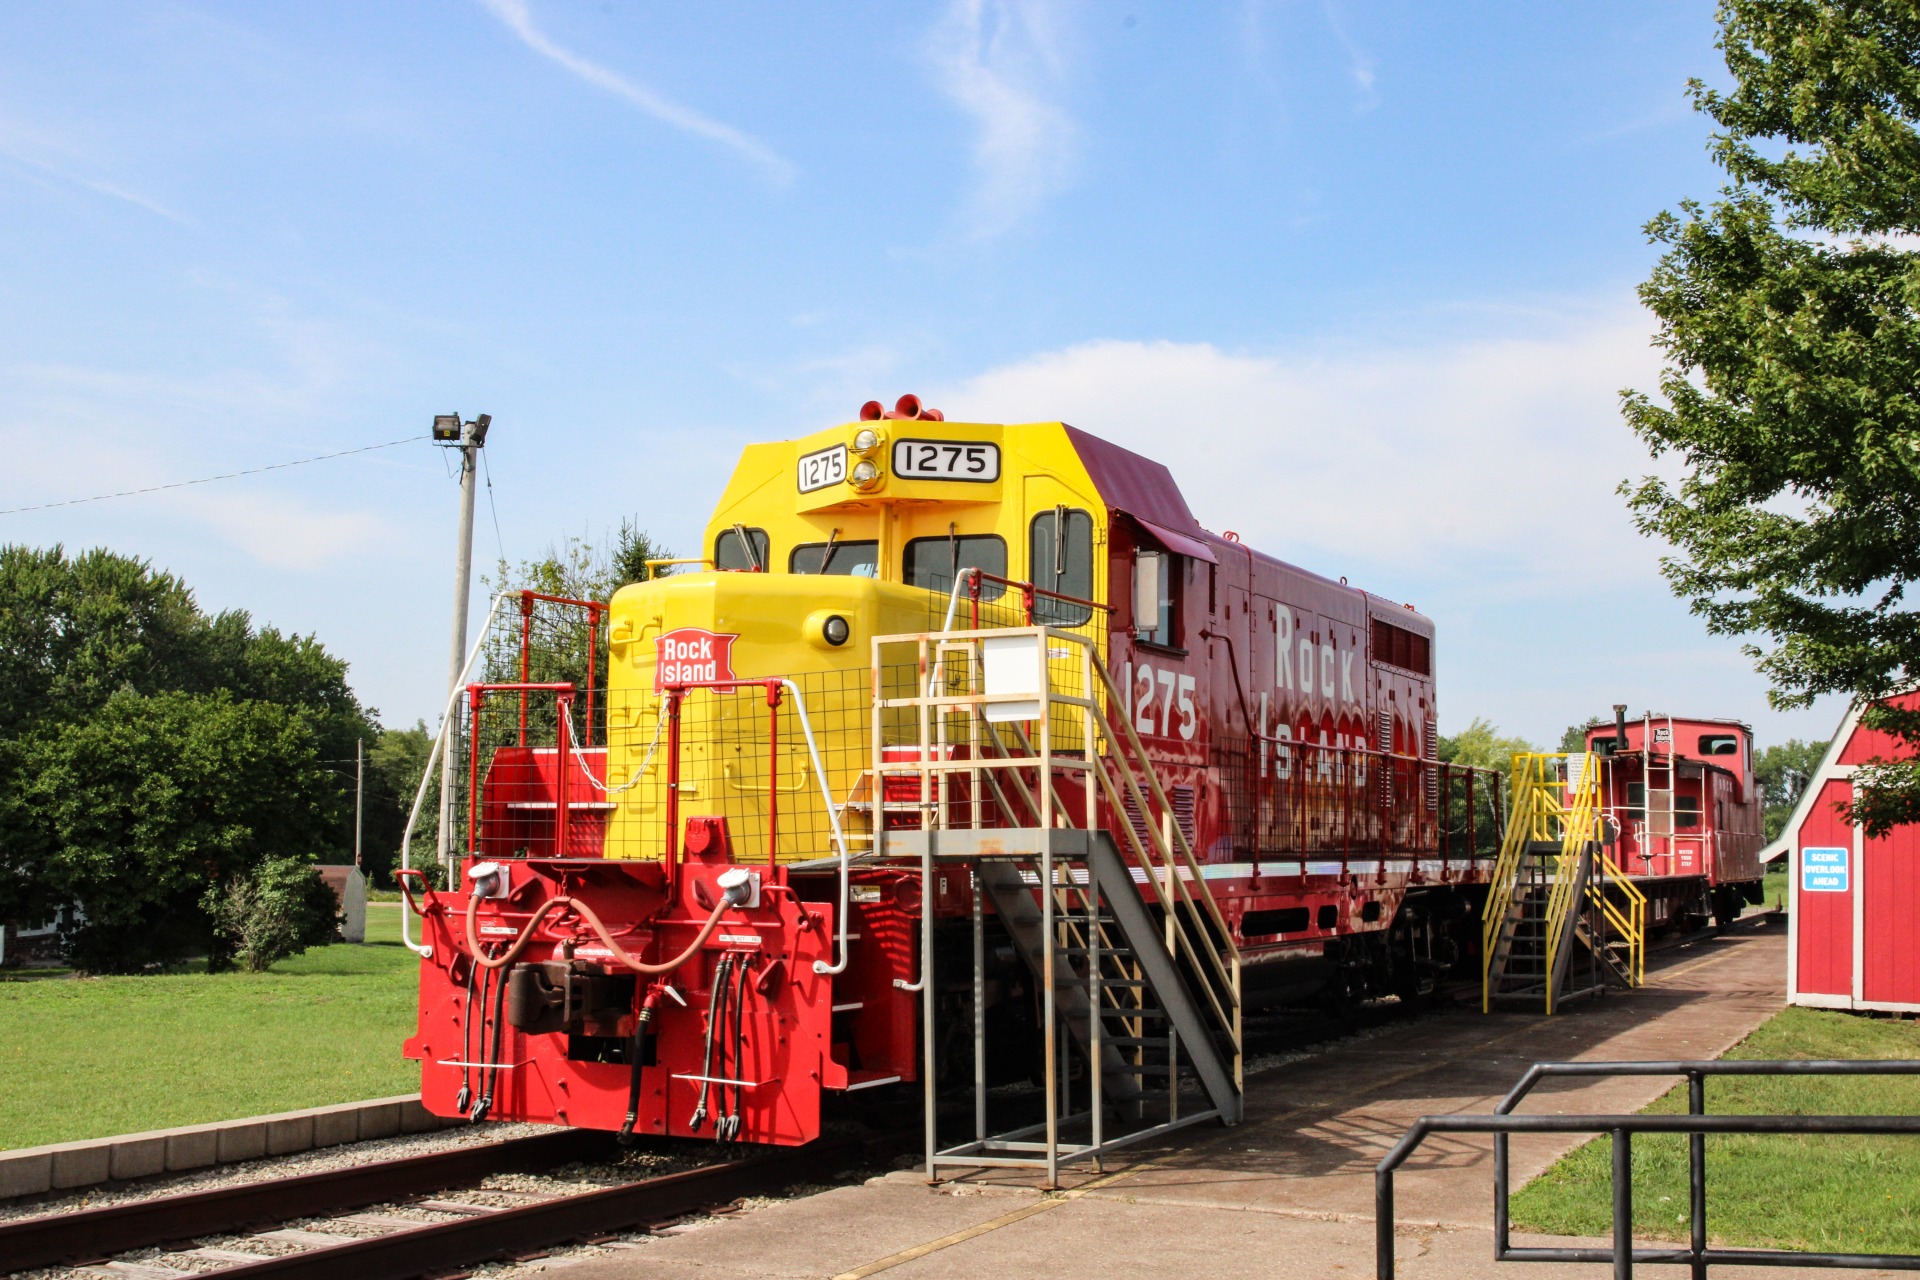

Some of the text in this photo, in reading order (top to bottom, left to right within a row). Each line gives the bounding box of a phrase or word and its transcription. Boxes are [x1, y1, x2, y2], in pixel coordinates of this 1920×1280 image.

[804, 452, 842, 487] 1275
[906, 445, 986, 473] 1275
[664, 637, 712, 660] Rock
[660, 660, 716, 682] Island
[1125, 661, 1196, 740] 1275
[1811, 853, 1839, 862] SCENIC
[1805, 865, 1846, 874] OVERLOOK
[1812, 877, 1839, 886] AHEAD
